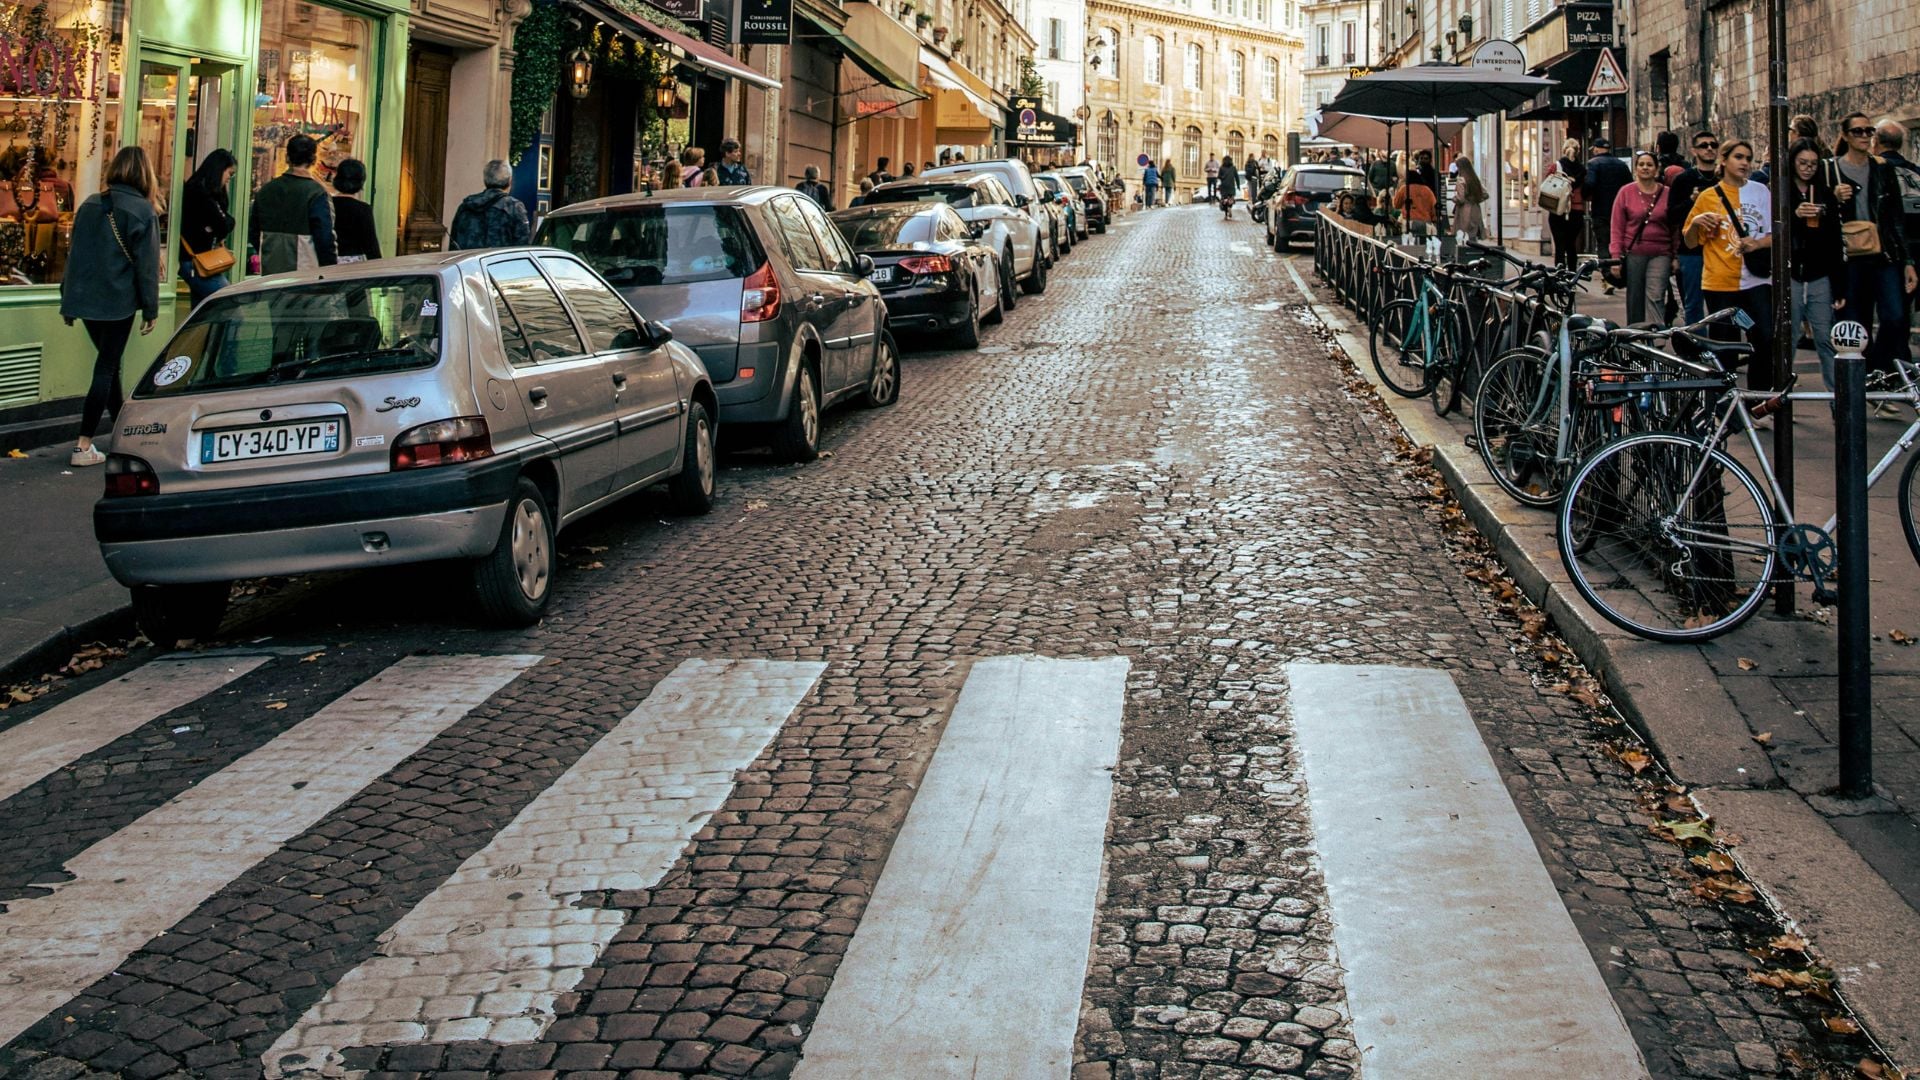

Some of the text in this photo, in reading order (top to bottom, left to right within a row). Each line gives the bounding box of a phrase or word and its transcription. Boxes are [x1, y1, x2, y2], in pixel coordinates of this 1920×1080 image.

[1576, 12, 1600, 20] PIZZA
[744, 21, 788, 30] ROUSSEL
[1585, 23, 1592, 32] A
[1563, 95, 1610, 108] PIZZA
[271, 81, 352, 136] ANOKI
[1834, 322, 1862, 339] LOVE
[1834, 338, 1861, 348] ME
[375, 396, 421, 413] Saxo
[122, 421, 168, 436] CITROËN
[218, 426, 321, 458] CY-340-YP
[325, 436, 337, 449] 75
